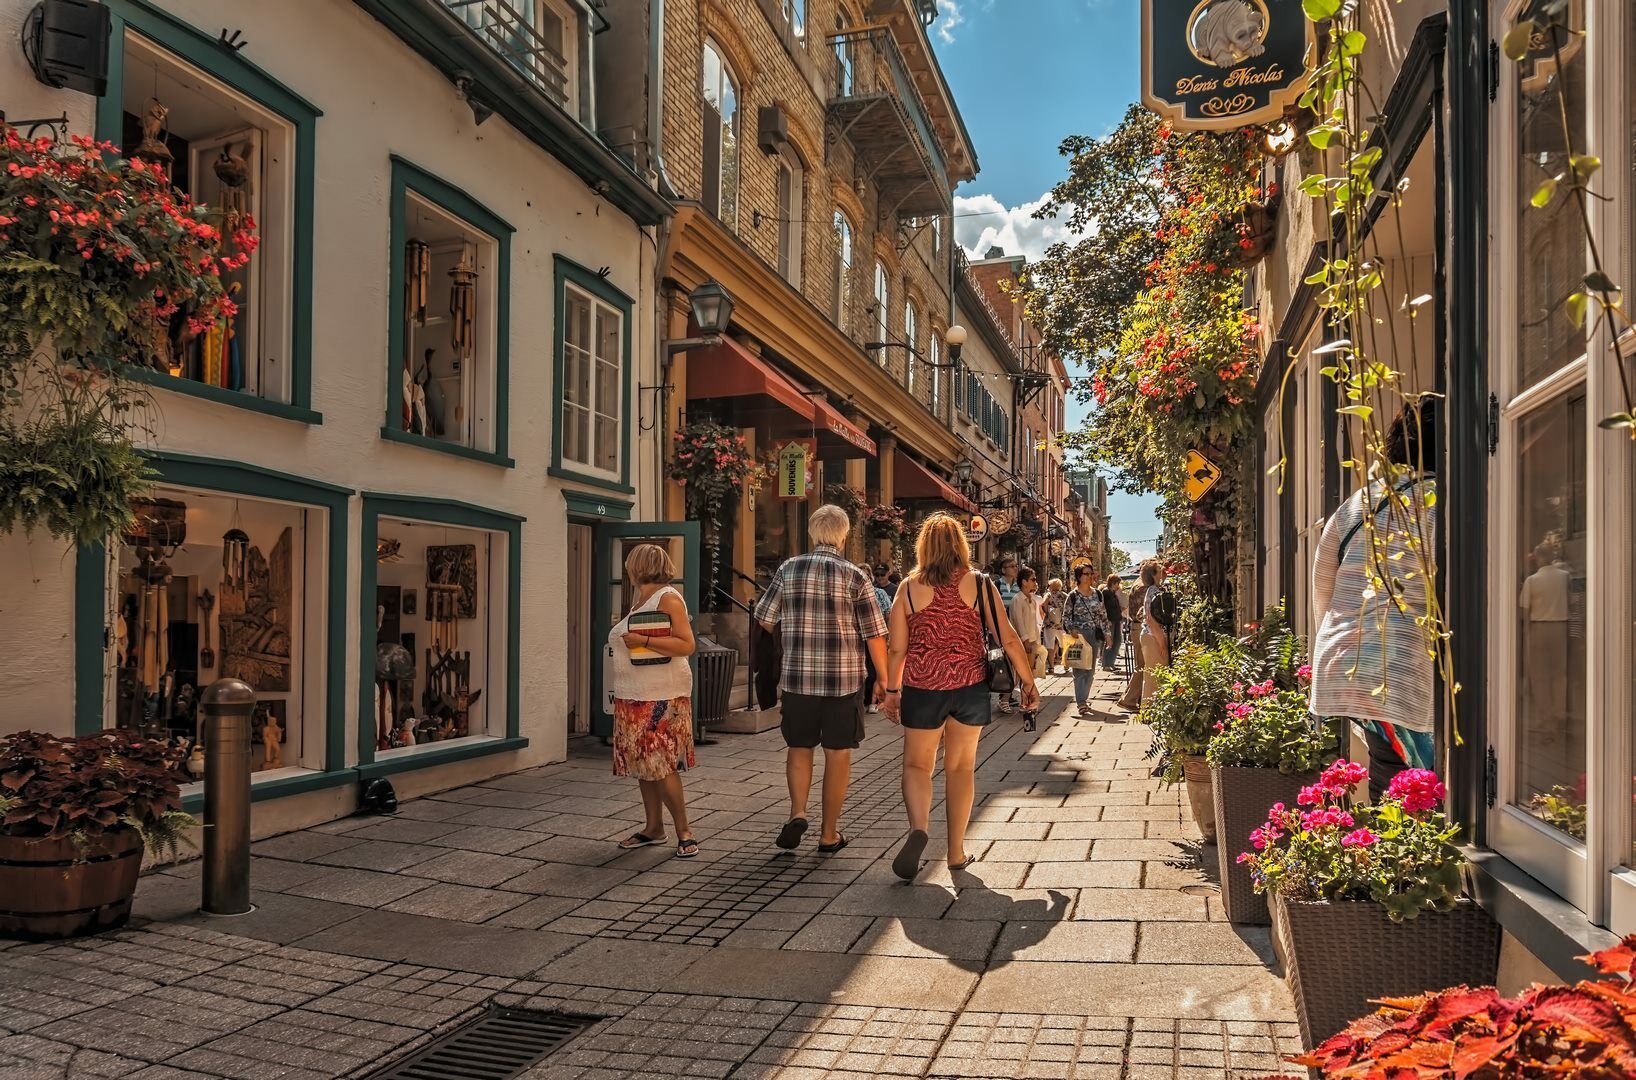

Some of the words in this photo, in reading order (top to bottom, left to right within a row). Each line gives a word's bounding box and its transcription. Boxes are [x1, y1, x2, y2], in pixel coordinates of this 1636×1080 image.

[1176, 75, 1219, 95] Denis
[1223, 63, 1284, 87] Nicolas
[788, 459, 797, 495] SOUVENIRS
[597, 504, 606, 515] 49
